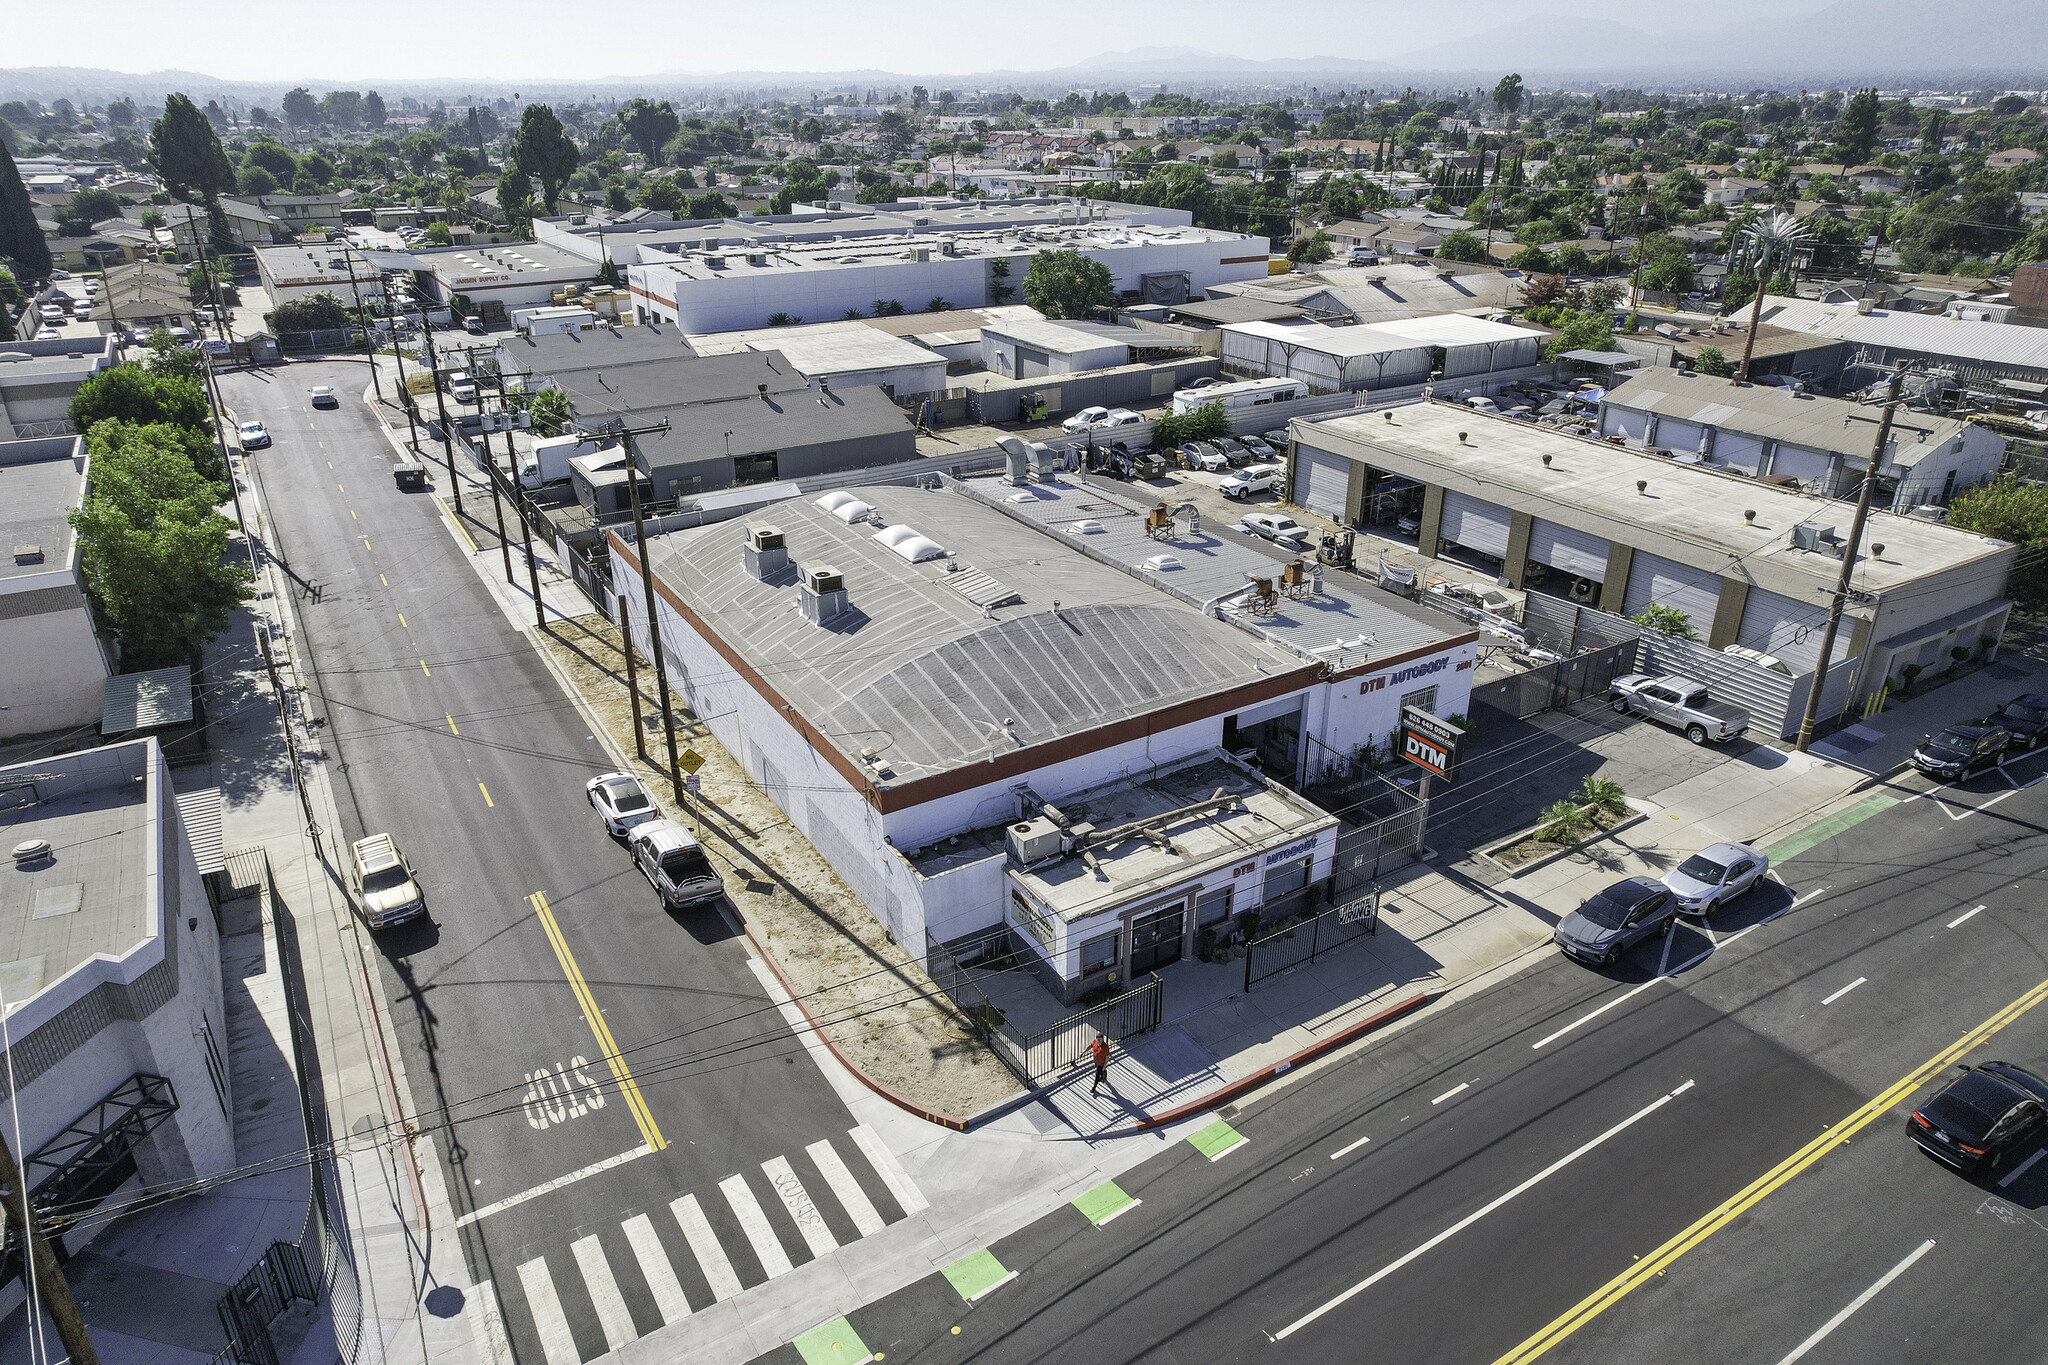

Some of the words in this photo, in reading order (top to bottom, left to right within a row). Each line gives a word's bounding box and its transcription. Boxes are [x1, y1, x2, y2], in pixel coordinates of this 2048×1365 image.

[1360, 676, 1386, 695] DTM
[1389, 656, 1450, 686] AUTOBODY
[1408, 713, 1421, 724] 626
[1421, 719, 1434, 731] 448
[1434, 725, 1451, 739] 0903
[1406, 736, 1447, 770] DTM
[1233, 861, 1256, 879] DTM
[1265, 835, 1318, 867] AUTOBODY
[522, 1055, 606, 1130] STOP
